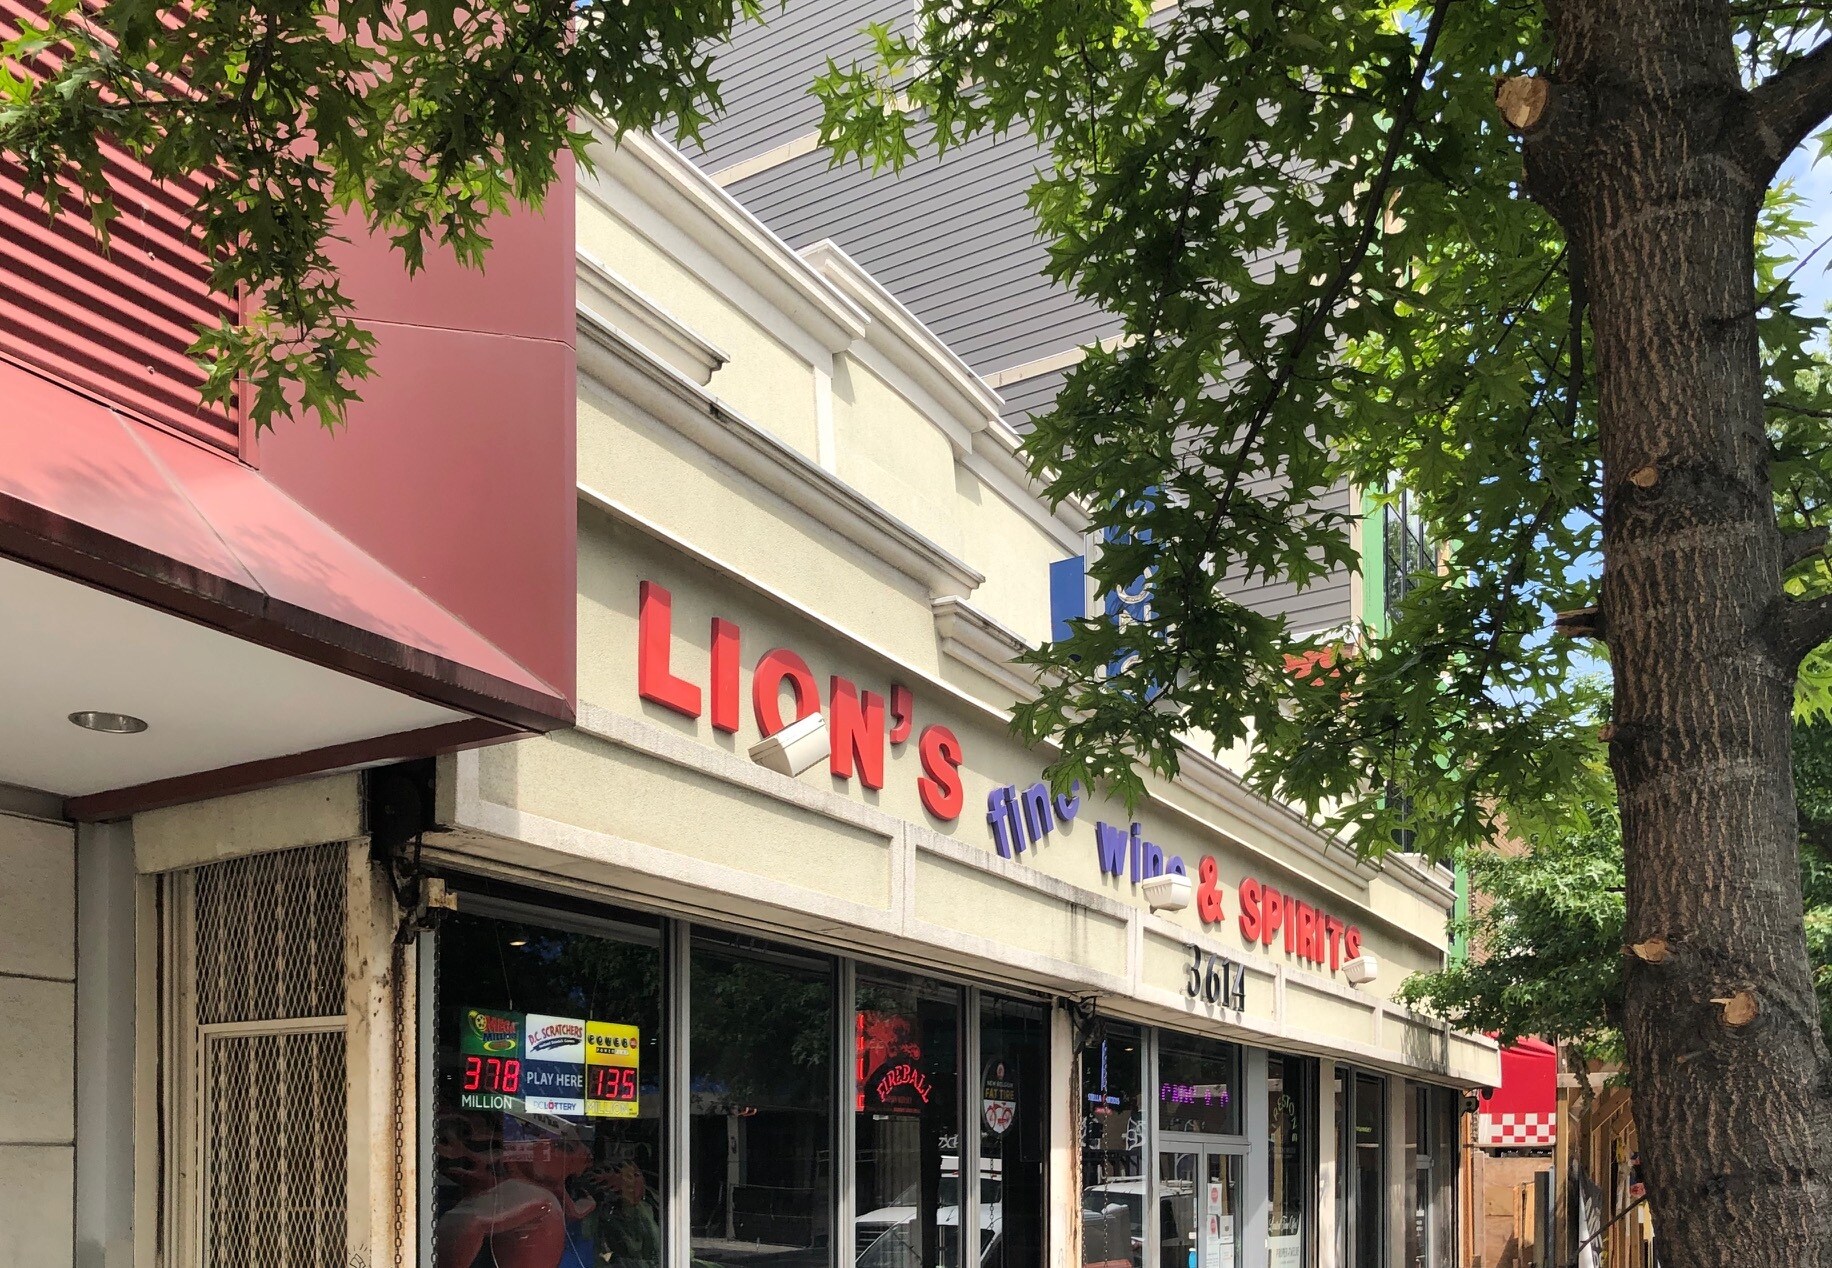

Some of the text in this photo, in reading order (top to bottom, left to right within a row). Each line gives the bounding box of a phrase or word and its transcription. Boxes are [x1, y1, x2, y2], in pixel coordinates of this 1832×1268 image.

[638, 580, 964, 821] LION'S
[1197, 854, 1226, 924] &
[1238, 876, 1363, 971] SPIRITS
[1186, 943, 1246, 1013] 3614
[542, 1024, 583, 1039] SCRATCHERS
[464, 1057, 521, 1092] 378
[526, 1071, 583, 1088] PLAY HERE
[596, 1068, 635, 1099] 135
[876, 1064, 932, 1103] FIREBALL
[461, 1094, 512, 1110] MILLION
[985, 1087, 999, 1098] FAT
